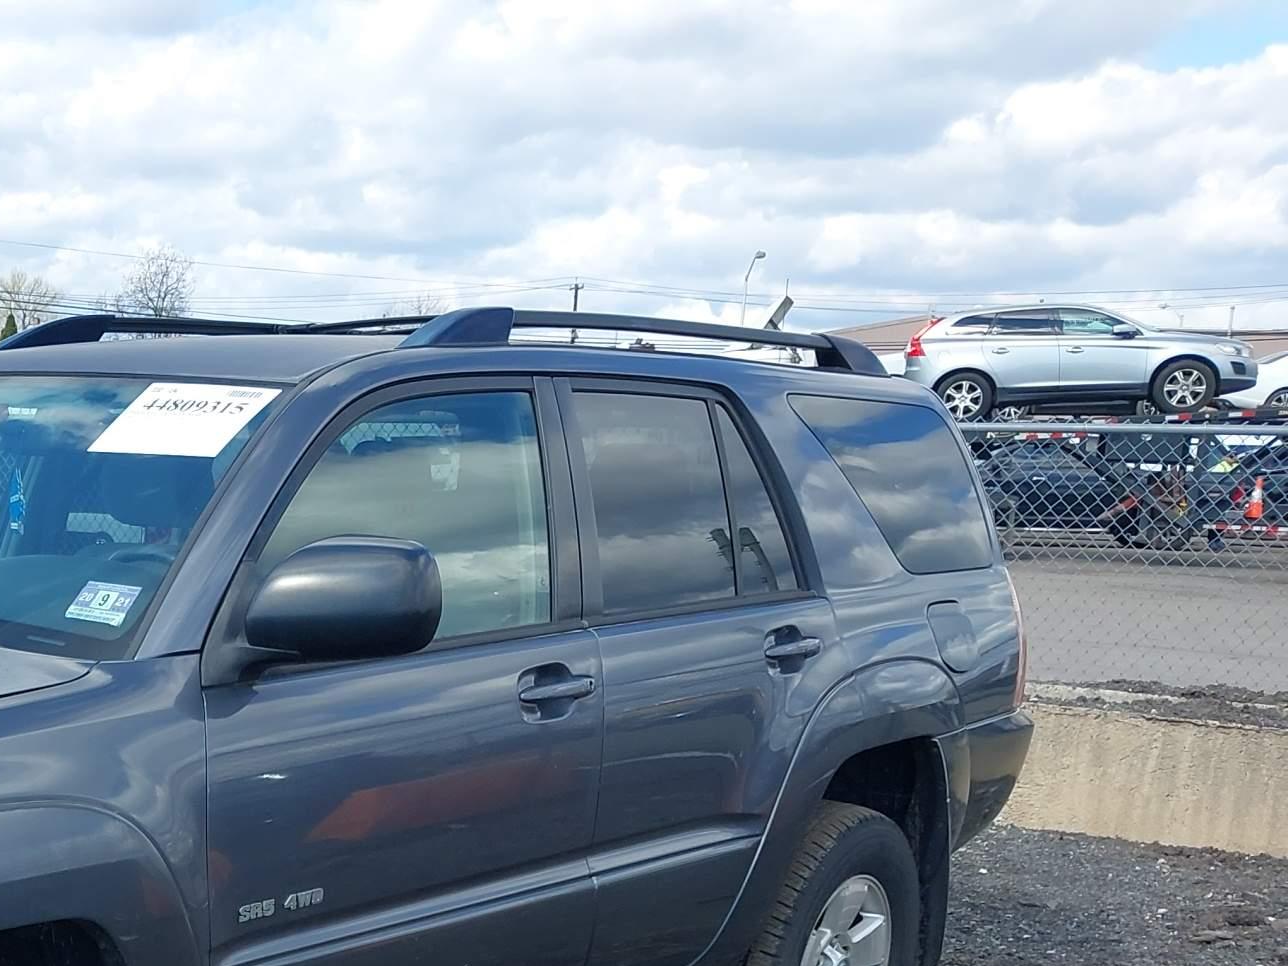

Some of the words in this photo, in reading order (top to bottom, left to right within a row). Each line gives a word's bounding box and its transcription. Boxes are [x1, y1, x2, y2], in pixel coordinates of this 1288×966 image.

[143, 397, 250, 415] 44809315
[79, 592, 95, 603] 20
[98, 593, 111, 607] 9
[114, 597, 132, 609] 21
[238, 898, 276, 923] SR5
[283, 887, 324, 911] 4WD
